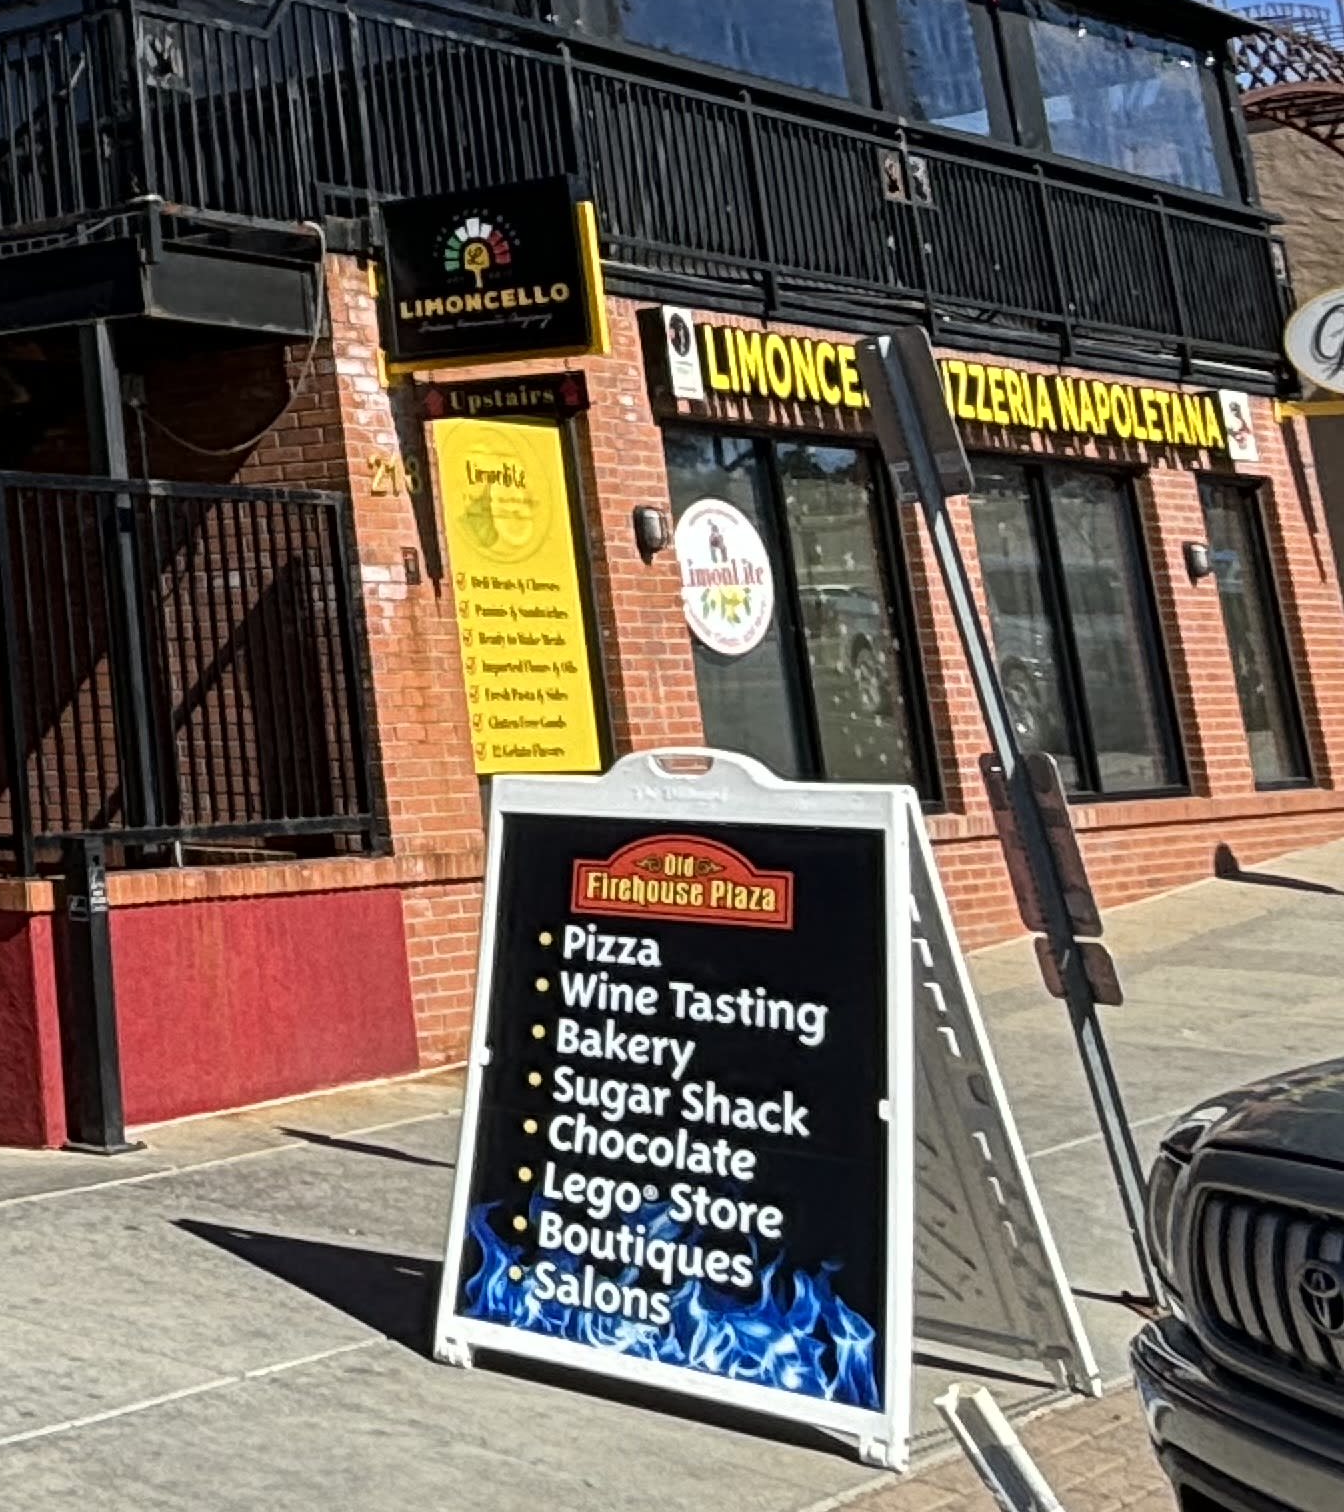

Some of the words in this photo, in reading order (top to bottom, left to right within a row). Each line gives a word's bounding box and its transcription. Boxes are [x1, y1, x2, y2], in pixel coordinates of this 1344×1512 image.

[399, 283, 570, 320] LIMONCELLO
[449, 385, 555, 415] Upstairs
[704, 324, 871, 407] LIMONCE
[940, 359, 1057, 431] IZZERIA
[1056, 376, 1225, 448] NAPOLETANA
[587, 872, 703, 907] Firehouse
[710, 880, 777, 912] Plaza
[664, 853, 694, 877] Old
[563, 925, 662, 967] Pizza
[559, 971, 660, 1016] Wine
[669, 981, 829, 1045] Tasting
[556, 1018, 696, 1080] Bakery
[552, 1066, 671, 1123] Sugar
[681, 1081, 811, 1138] Shack
[547, 1113, 758, 1182] Chocolate
[669, 1184, 784, 1239] Store
[538, 1210, 755, 1288] Boutiques
[533, 1261, 673, 1326] Salons
